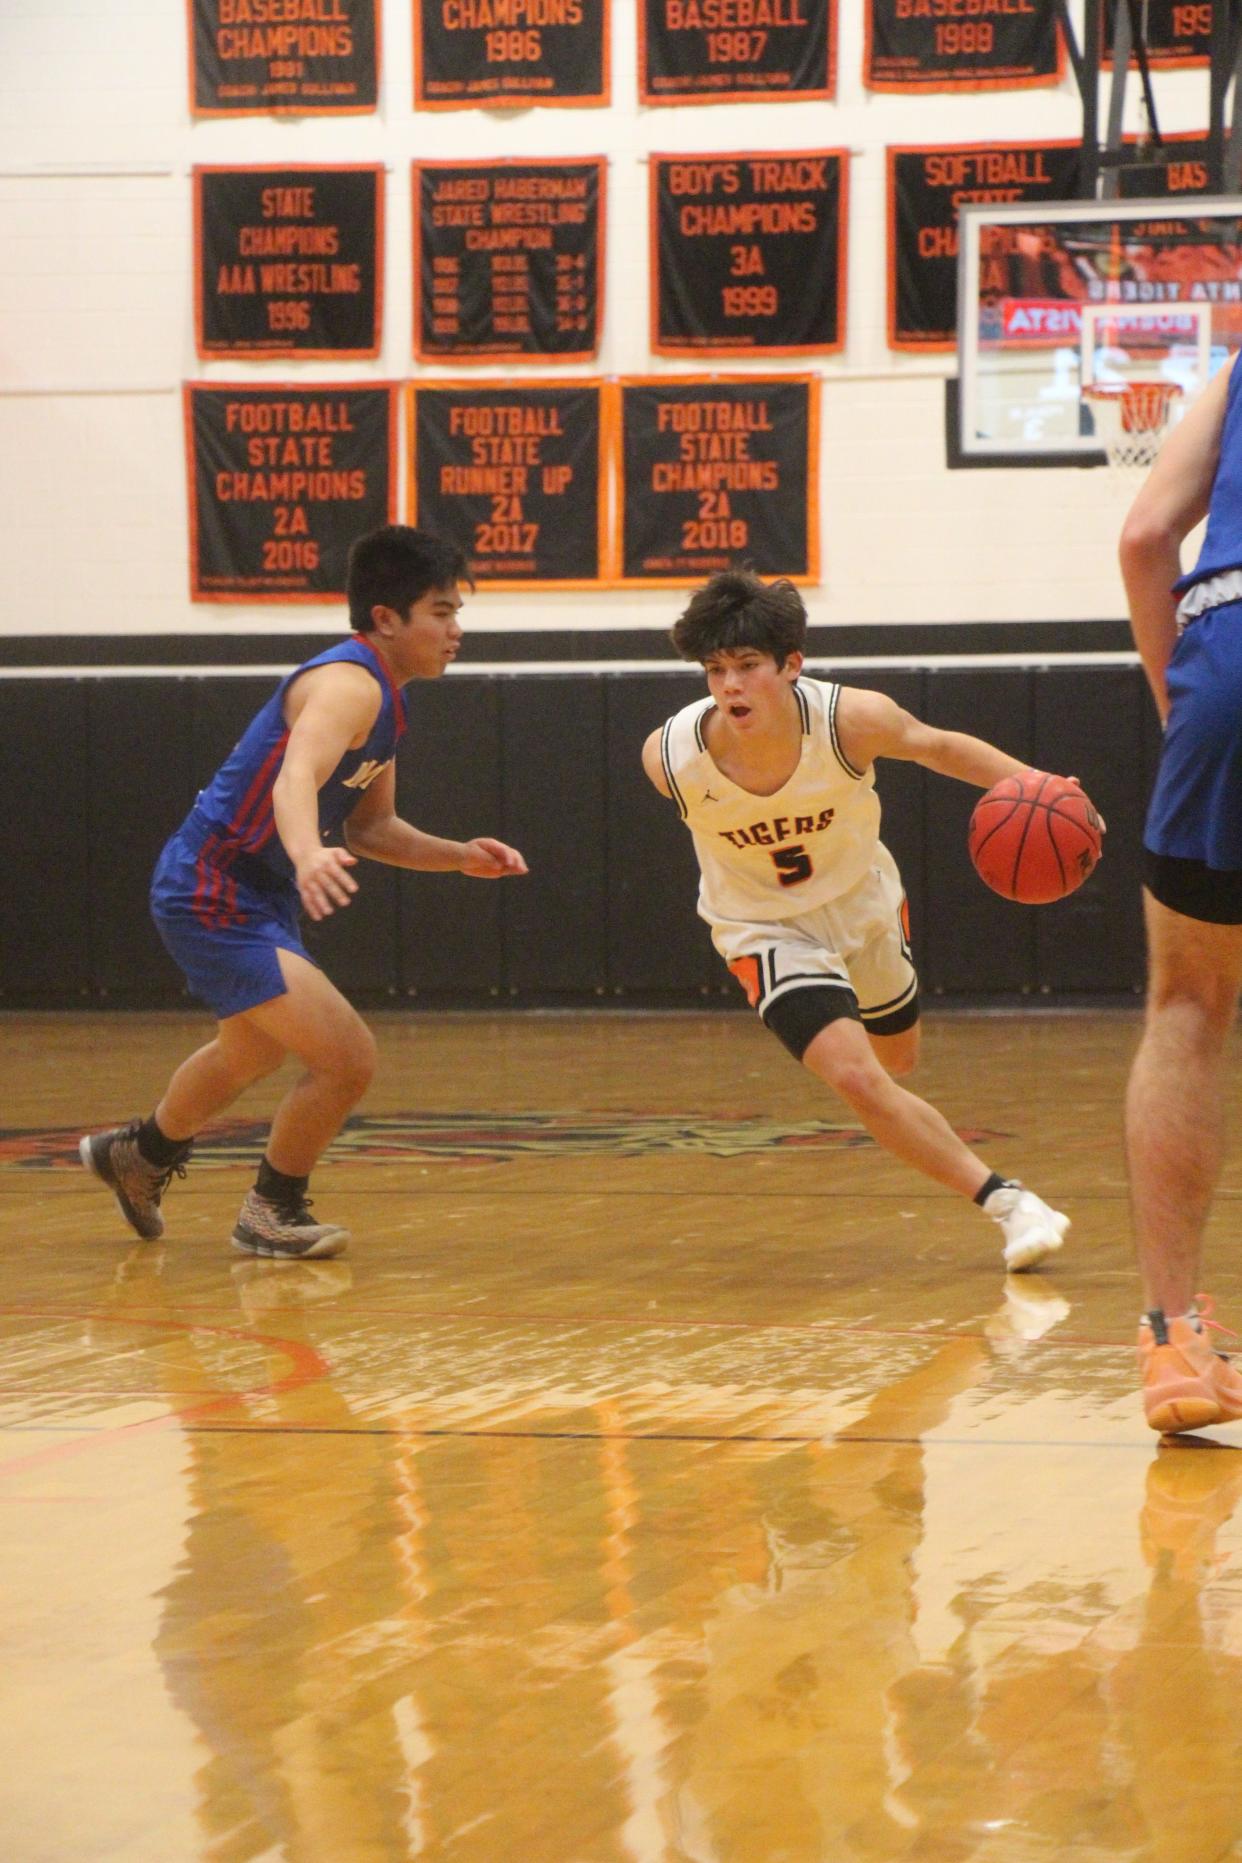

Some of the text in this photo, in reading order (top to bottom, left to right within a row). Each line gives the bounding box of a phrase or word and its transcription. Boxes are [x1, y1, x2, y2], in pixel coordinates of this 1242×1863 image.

[218, 0, 349, 24] BASEBALL
[443, 0, 583, 30] CHAMPIONS
[666, 0, 808, 30] BASEBALL
[1173, 5, 1213, 37] 199
[216, 25, 353, 60] CHAMPIONS
[486, 29, 542, 63] 1986
[706, 31, 768, 63] 1987
[935, 22, 993, 55] 1988
[669, 160, 827, 195] BOY'S TRACK
[925, 153, 1052, 186] SOFTBALL
[262, 186, 315, 218] STATE
[432, 204, 485, 227] STATE
[680, 202, 817, 236] CHAMPIONS
[239, 226, 338, 256] CHAMPIONS
[730, 245, 765, 276] 3A
[217, 263, 361, 295] AAA WRESTLING
[722, 285, 779, 317] 1999
[225, 402, 354, 433] FOOTBALL
[449, 407, 564, 437] FOOTBALL
[657, 401, 773, 432] FOOTBALL
[247, 436, 333, 467] STATE
[472, 436, 541, 466] STATE
[680, 431, 751, 462] STATE
[215, 470, 366, 502] CHAMPIONS
[440, 465, 573, 496] RUNNER UP
[652, 460, 779, 493] CHAMPIONS
[491, 495, 524, 523] 2A
[698, 490, 730, 520] 2A
[273, 506, 309, 536] 2A
[681, 519, 748, 550] 2018
[475, 523, 540, 554] 2017
[263, 539, 320, 570] 2016
[718, 807, 835, 850] TIGERS
[769, 843, 814, 888] 5
